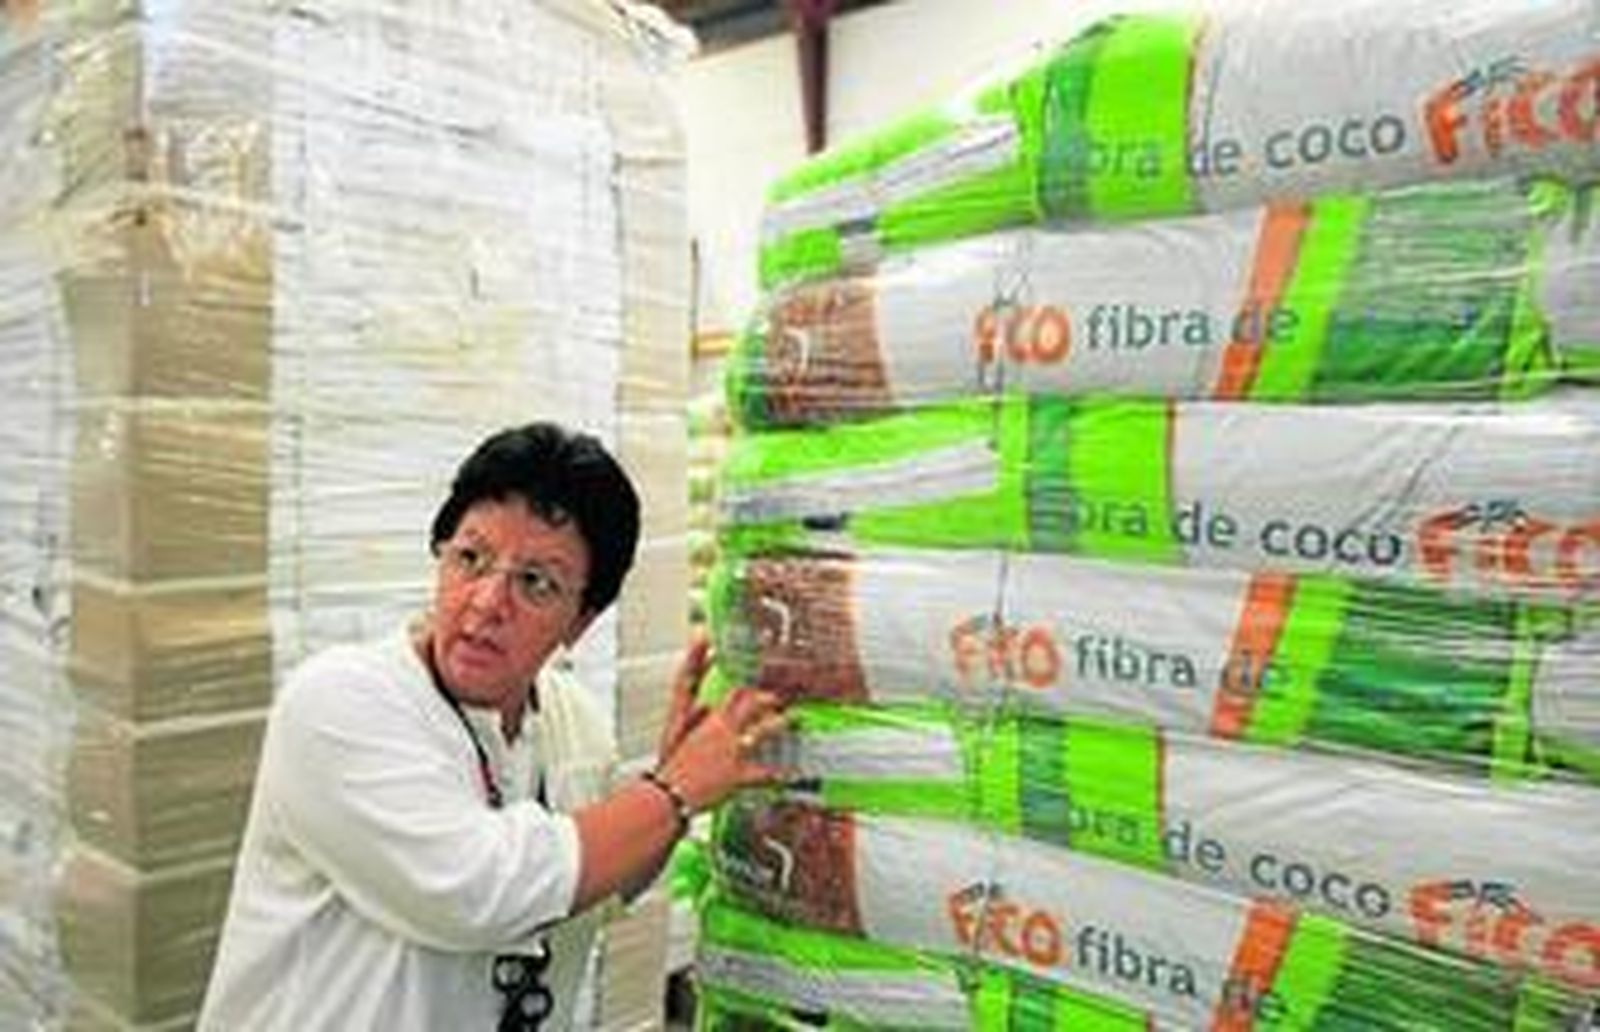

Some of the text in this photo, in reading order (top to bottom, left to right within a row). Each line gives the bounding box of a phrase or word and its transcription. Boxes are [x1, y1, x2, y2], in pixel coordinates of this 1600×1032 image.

[1264, 115, 1404, 169] coco
[1086, 304, 1211, 349] fibra
[1231, 306, 1300, 347] de
[1171, 499, 1237, 548] de
[1259, 520, 1402, 566] coco
[1074, 634, 1197, 688] fibra
[1164, 818, 1226, 874] de
[1249, 850, 1391, 918] coco
[1074, 925, 1198, 998] fibra
